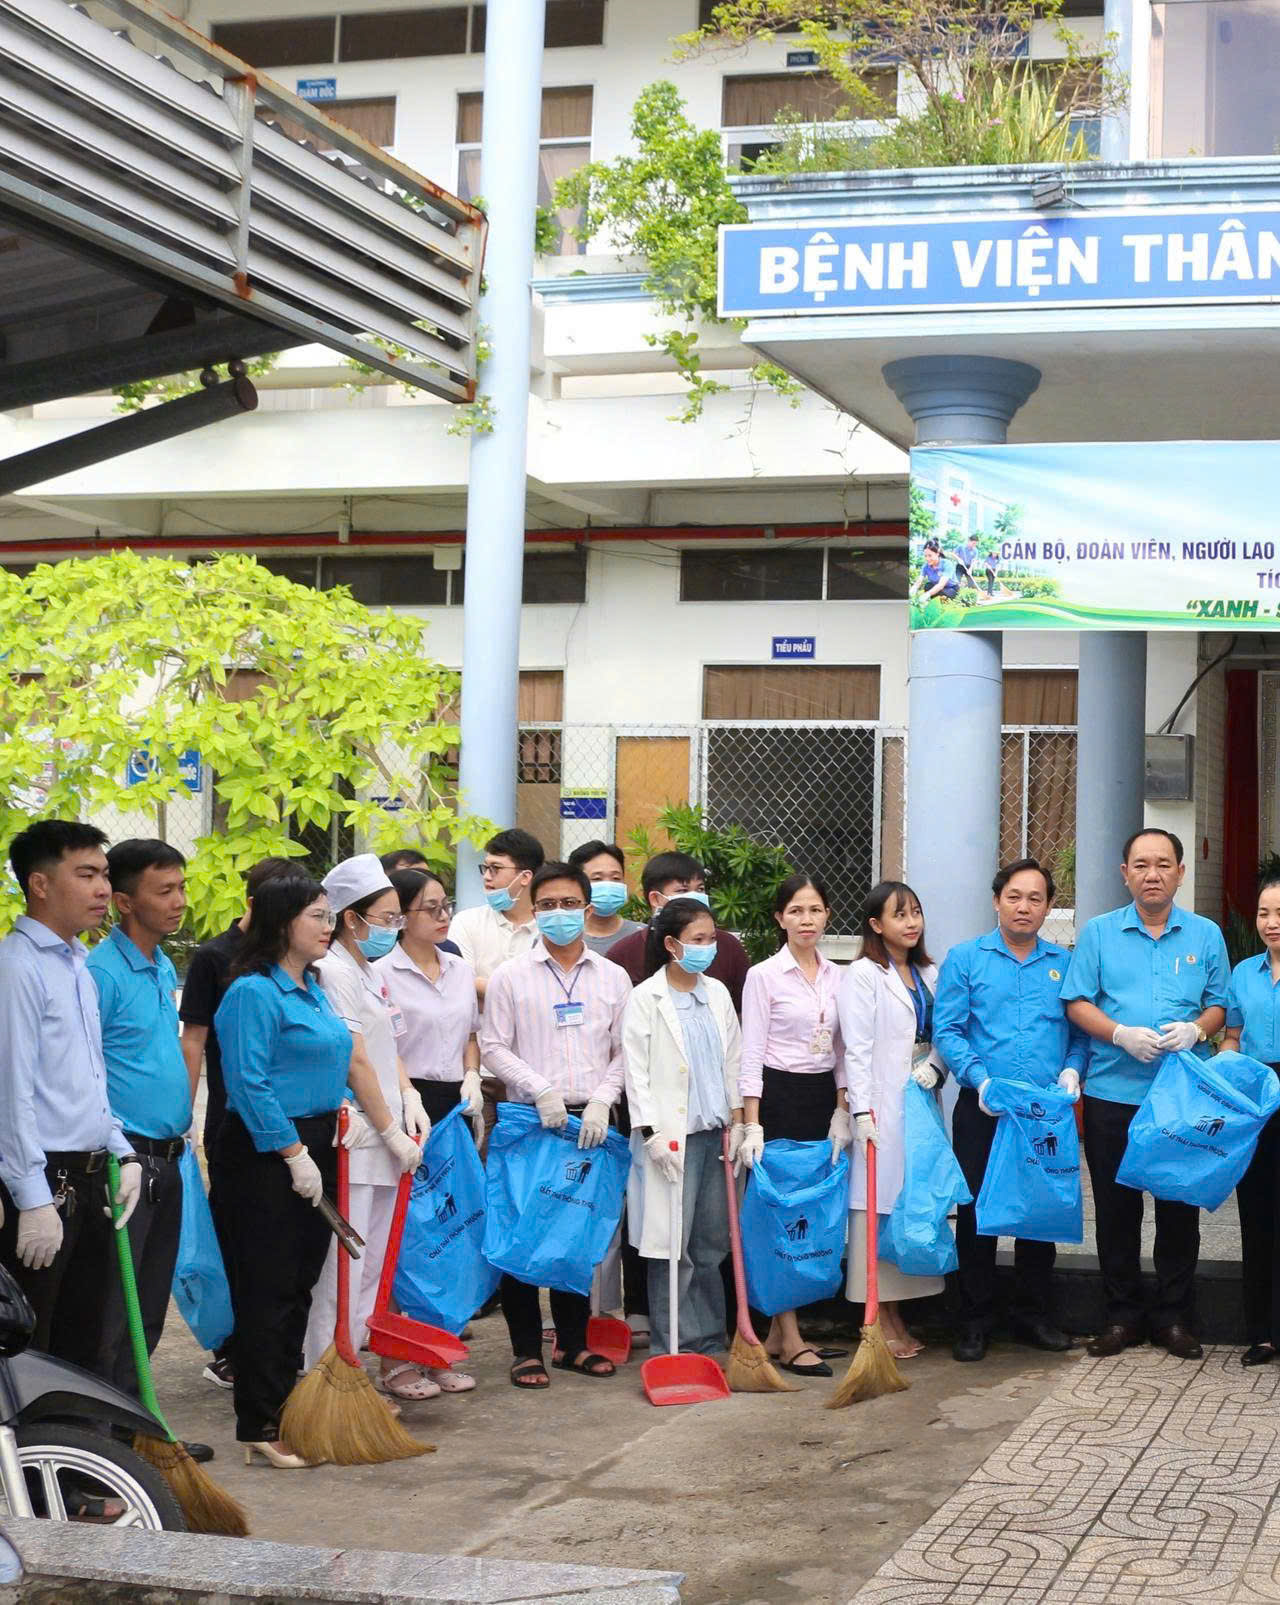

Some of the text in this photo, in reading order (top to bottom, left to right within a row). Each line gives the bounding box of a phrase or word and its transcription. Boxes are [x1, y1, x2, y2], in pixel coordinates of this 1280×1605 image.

[759, 231, 929, 302] BỆNH
[953, 226, 1098, 296] VIỆN
[1001, 538, 1036, 560] CÁN
[1043, 539, 1071, 564] BỘ,
[1076, 538, 1125, 560] ĐOÀN
[1131, 539, 1176, 562] VIÊN,
[1182, 538, 1236, 560] NGƯỜI
[1243, 541, 1274, 560] LAO
